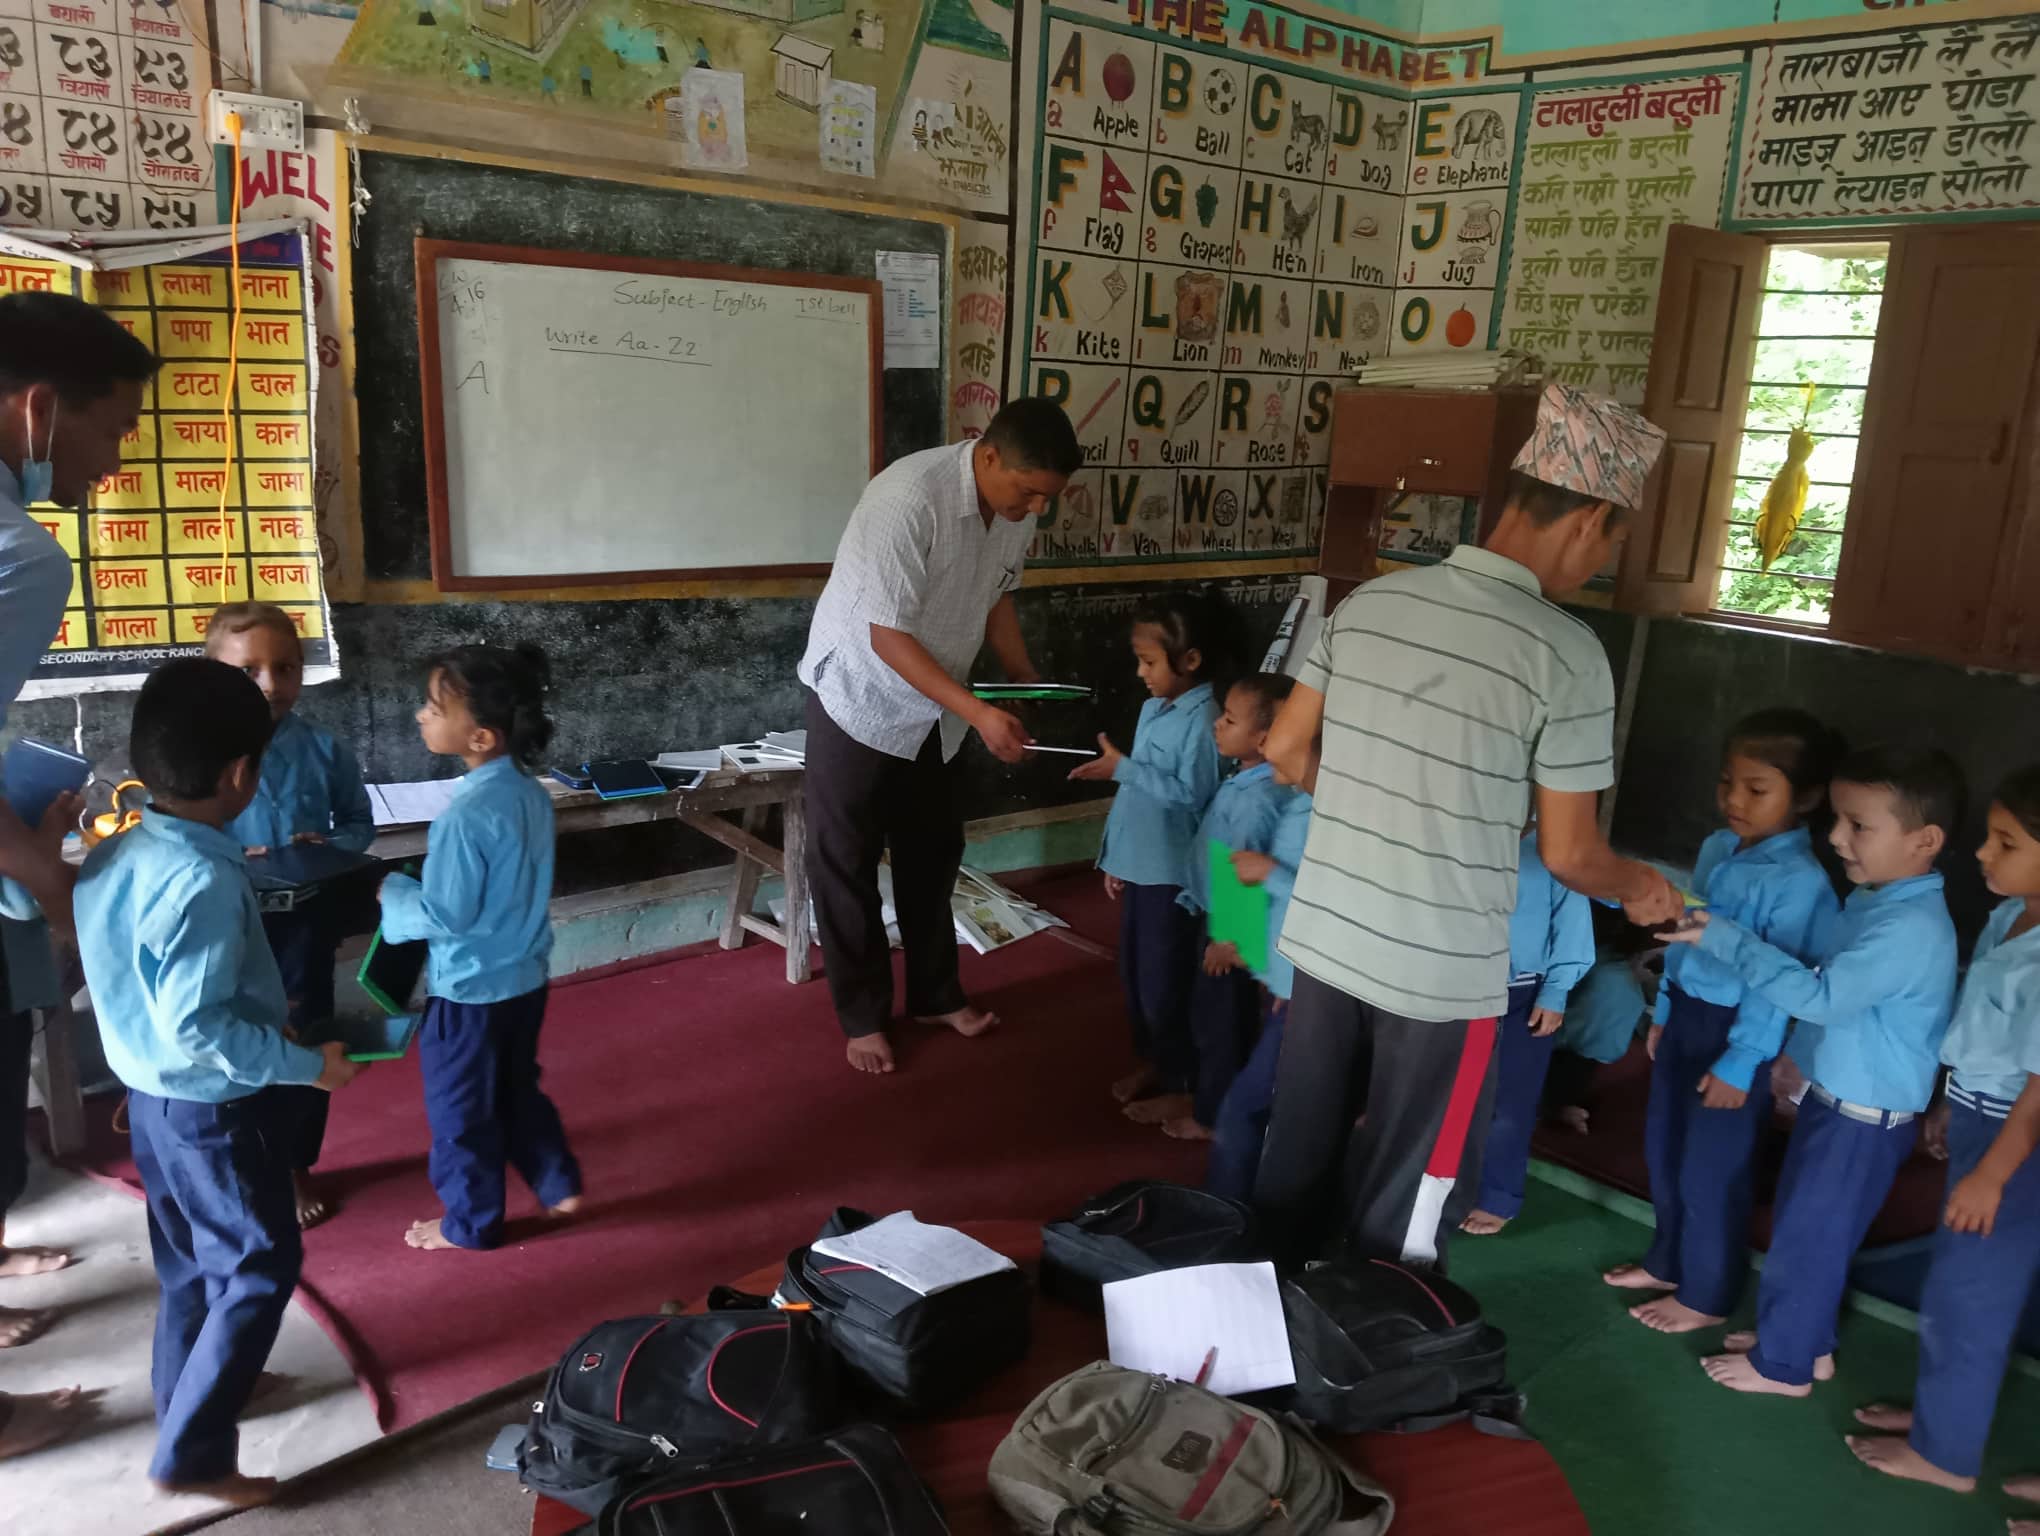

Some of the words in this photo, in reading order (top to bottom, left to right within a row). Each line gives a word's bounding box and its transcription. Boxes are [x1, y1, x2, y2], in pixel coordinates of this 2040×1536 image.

[51, 33, 112, 79] ८३
[1239, 8, 1485, 83] ALPHABET
[1051, 31, 1084, 95] A
[1160, 52, 1195, 116] B
[1250, 74, 1284, 135] C
[1333, 93, 1365, 150] D
[1414, 103, 1452, 158] E
[1536, 84, 1644, 138] टालाटुली
[1645, 75, 1726, 129] बटुली
[1771, 91, 1857, 127] मामा
[57, 108, 119, 156] ८४
[1094, 105, 1139, 139] Apple
[1195, 126, 1230, 156] Ball
[1284, 145, 1313, 174] Cat
[1360, 159, 1393, 191] Dog
[1437, 160, 1509, 189] Elephant
[1048, 143, 1086, 207] F
[1150, 165, 1184, 221] G
[1240, 180, 1273, 235] H
[1411, 201, 1447, 252] J
[1751, 179, 1824, 208] पापा
[1084, 216, 1124, 254] Flag
[1180, 231, 1232, 266] Grapes
[1272, 244, 1307, 274] Hen
[1351, 255, 1384, 285] Iron
[1442, 259, 1475, 286] Jug
[161, 274, 212, 296] लामा
[241, 275, 289, 298] नाना
[1040, 259, 1074, 321] K
[1142, 271, 1171, 329] L
[1227, 280, 1263, 335] M
[1314, 289, 1345, 340] N
[1400, 297, 1432, 344] O
[171, 320, 212, 342] पापा
[245, 322, 289, 345] भात
[545, 326, 599, 347] Write
[1076, 329, 1121, 360] Kite
[1172, 338, 1209, 362] Lion
[174, 373, 220, 396] टाटा
[251, 374, 296, 396] दाल
[1132, 374, 1166, 431] Q
[1220, 377, 1252, 431] R
[1304, 381, 1333, 434] S
[255, 423, 300, 445] कान
[1079, 436, 1109, 462] ncil
[1160, 439, 1199, 464] Quill
[1247, 440, 1287, 463] Rose
[258, 473, 304, 493] जामा
[1110, 474, 1141, 526] V
[1180, 474, 1216, 525] W
[1248, 474, 1278, 520] X
[98, 520, 149, 543] तामा
[183, 518, 235, 541] ताला
[260, 517, 304, 539] नाक
[1133, 533, 1161, 556] Van
[95, 568, 148, 590] छाला
[258, 565, 310, 587] खाजा
[105, 616, 157, 639] गाला
[40, 651, 114, 665] SECONDARY
[118, 649, 166, 662] SCHOOL
